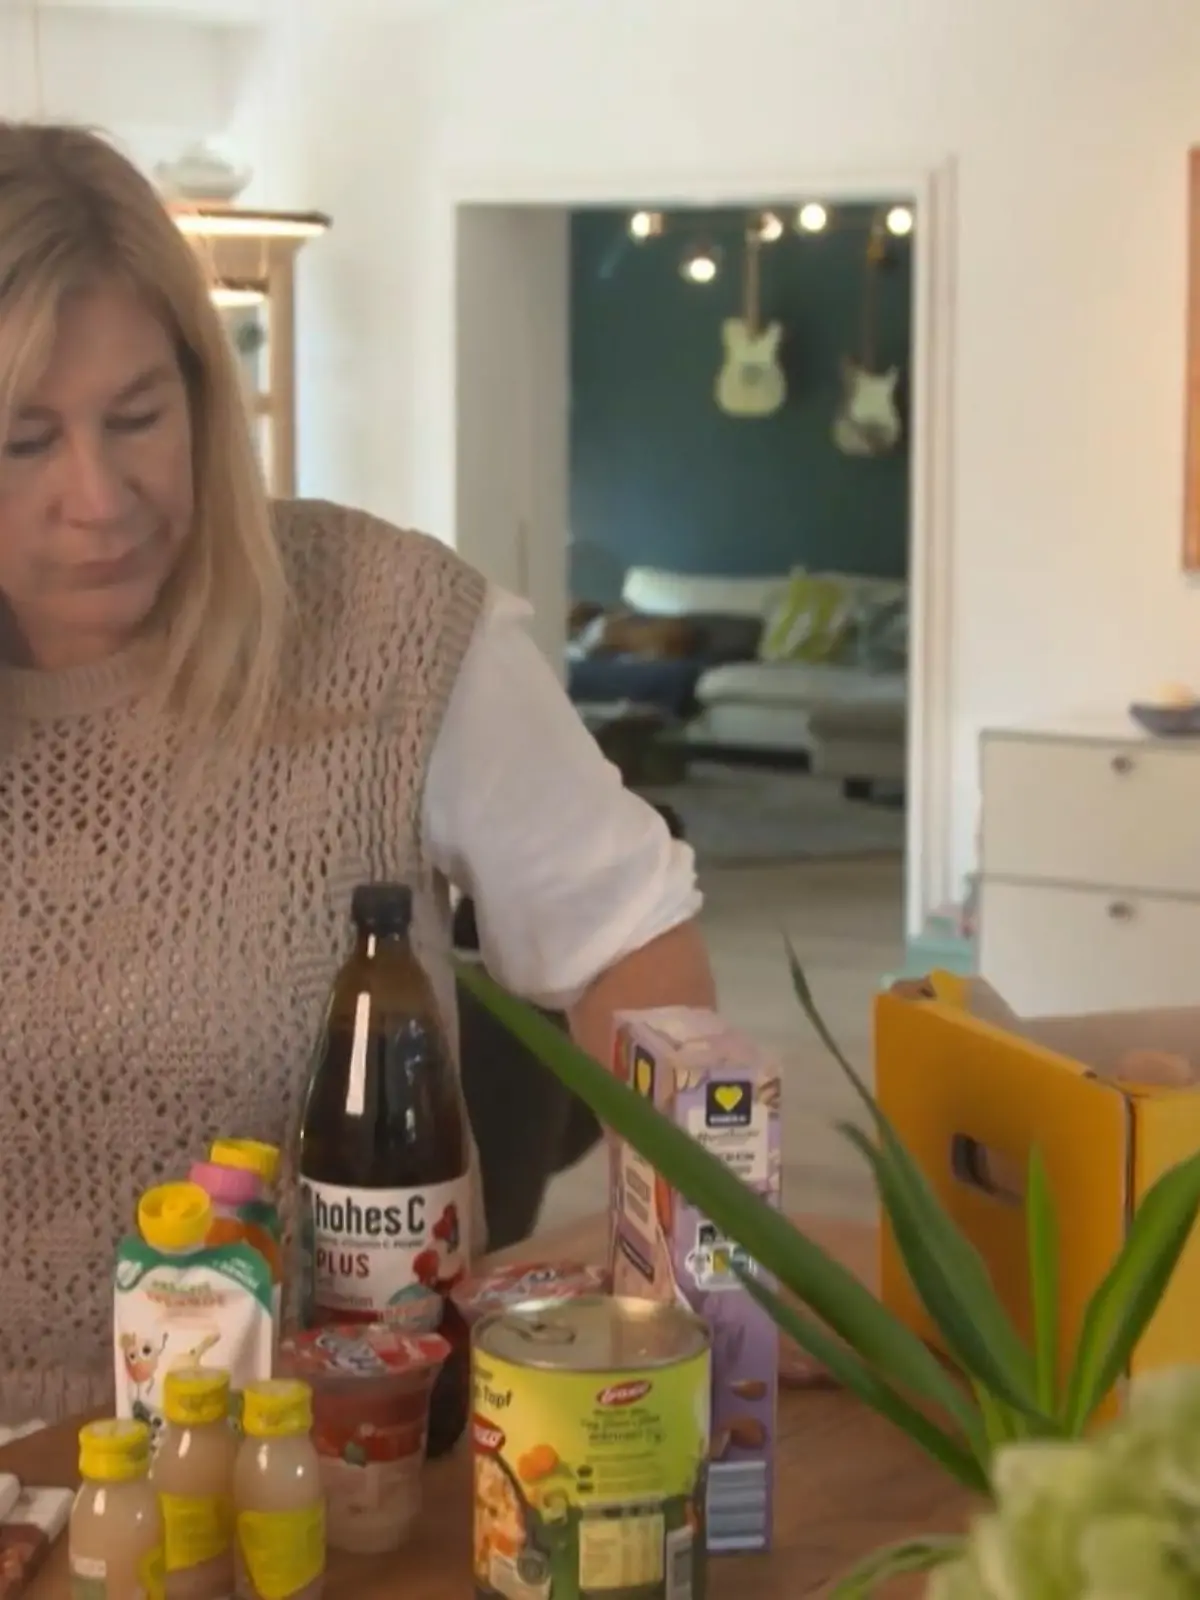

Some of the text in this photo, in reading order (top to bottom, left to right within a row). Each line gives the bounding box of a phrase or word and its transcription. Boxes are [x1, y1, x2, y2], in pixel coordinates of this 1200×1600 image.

[316, 1192, 425, 1236] hohes C
[316, 1248, 370, 1278] PLUS
